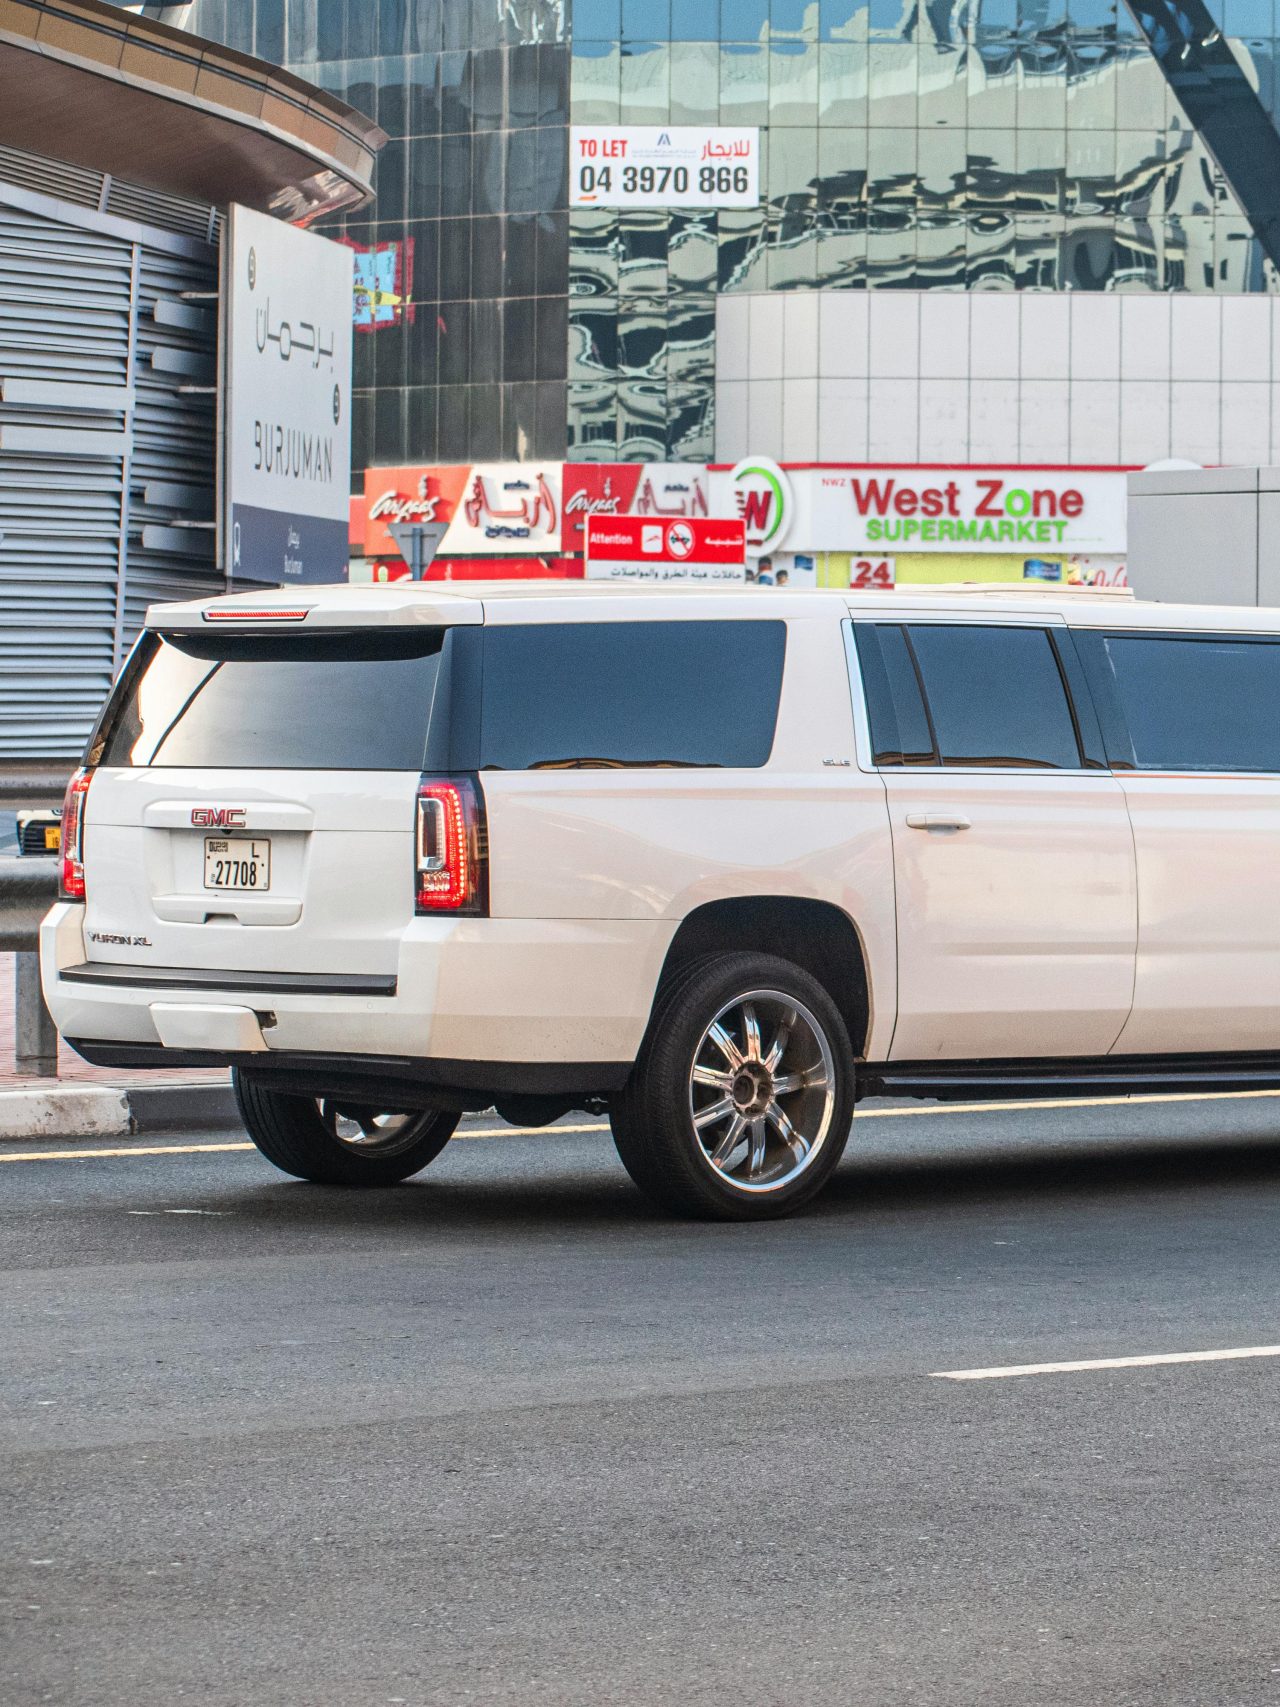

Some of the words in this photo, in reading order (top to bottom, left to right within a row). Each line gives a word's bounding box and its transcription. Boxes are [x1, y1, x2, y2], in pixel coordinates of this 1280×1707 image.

[579, 139, 597, 157] TO
[602, 140, 628, 157] LET
[701, 139, 750, 161] للايجار
[580, 166, 612, 193] 04
[622, 166, 688, 193] 3970
[699, 166, 748, 193] 866
[256, 297, 334, 373] برجمان
[255, 420, 333, 482] BURJUMAN
[822, 478, 846, 487] NWZ
[851, 479, 960, 516] West
[975, 480, 1084, 517] Zone
[590, 532, 633, 545] Attention
[866, 519, 1068, 543] SUPERMARKET
[611, 567, 658, 579] والمواصلات
[662, 568, 687, 580] الطرق
[856, 561, 890, 582] 24
[191, 808, 247, 828] GMC
[252, 842, 260, 858] L
[215, 861, 257, 886] 27708
[133, 936, 153, 947] XL
